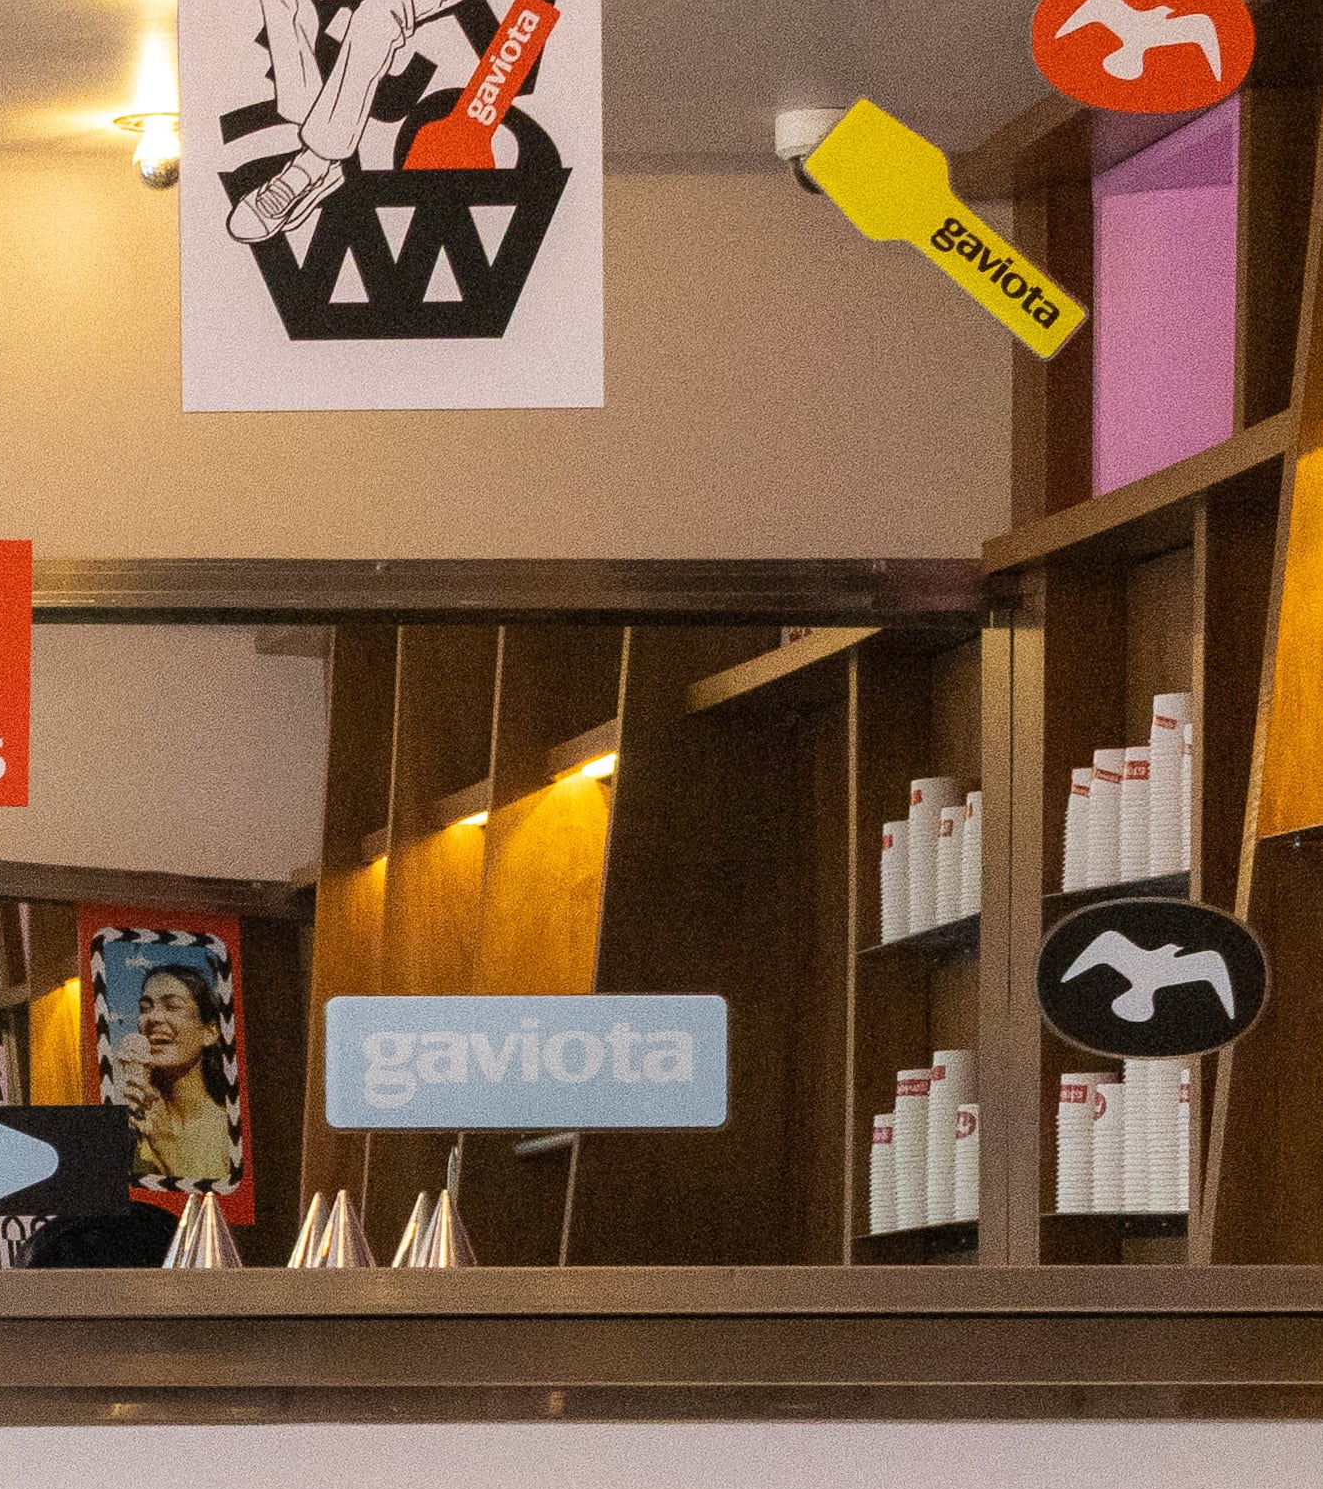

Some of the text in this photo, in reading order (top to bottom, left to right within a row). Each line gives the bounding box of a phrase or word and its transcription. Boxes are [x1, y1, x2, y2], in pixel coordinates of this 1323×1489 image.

[466, 9, 541, 127] gaviota
[930, 217, 1060, 330] gaviota
[362, 1016, 695, 1109] gaviota
